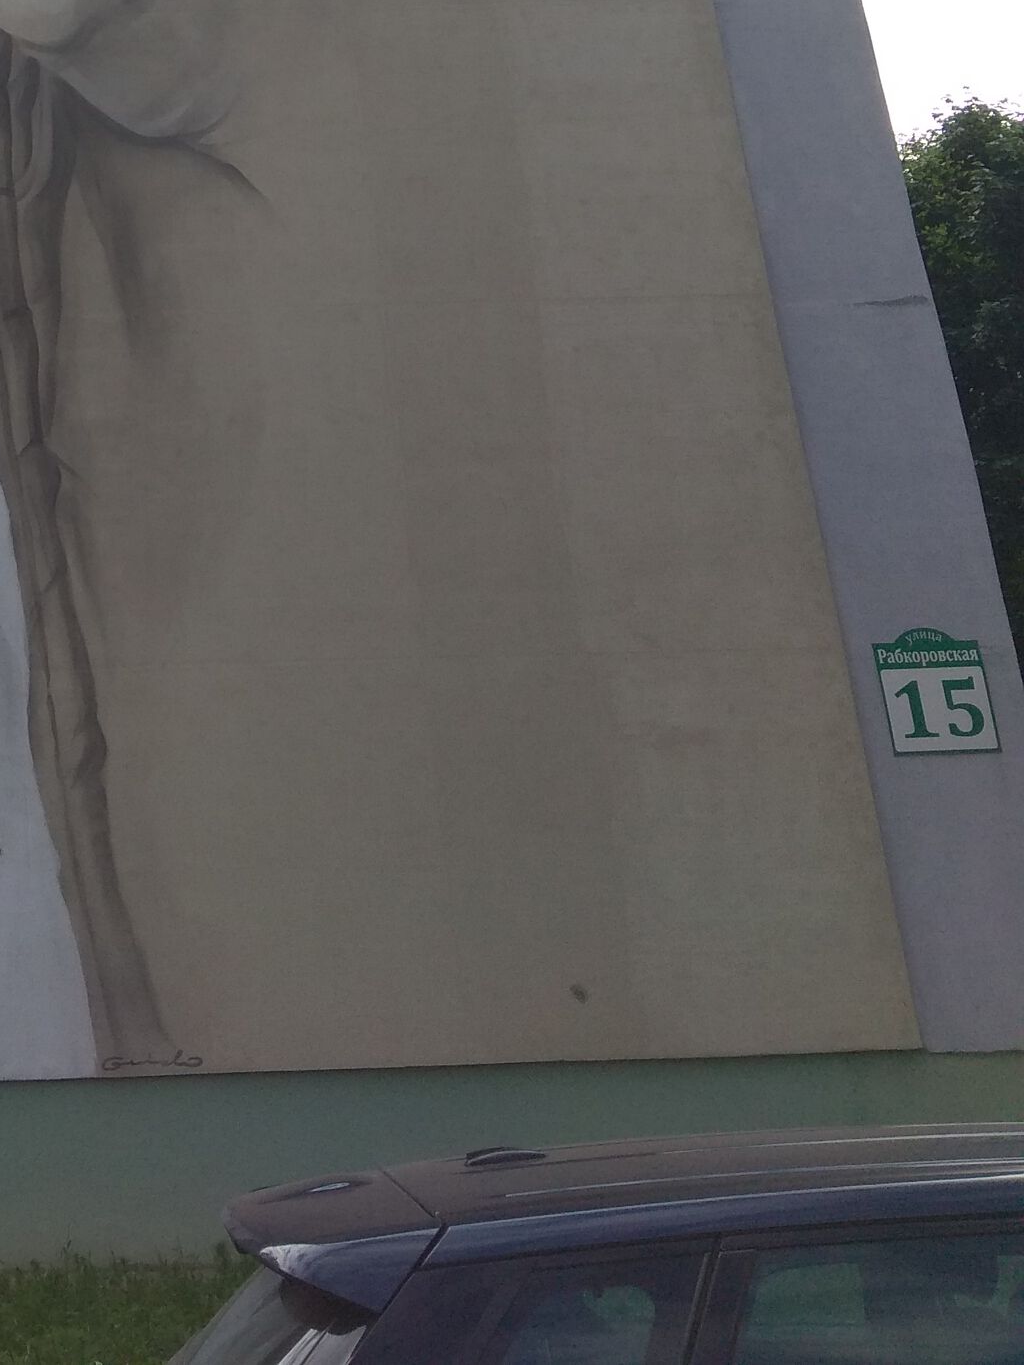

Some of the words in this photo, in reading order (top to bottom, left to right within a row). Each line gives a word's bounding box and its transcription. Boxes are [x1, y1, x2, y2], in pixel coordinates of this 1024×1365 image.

[905, 631, 942, 645] улица
[878, 648, 979, 666] Рабкоровская
[894, 676, 985, 739] 15
